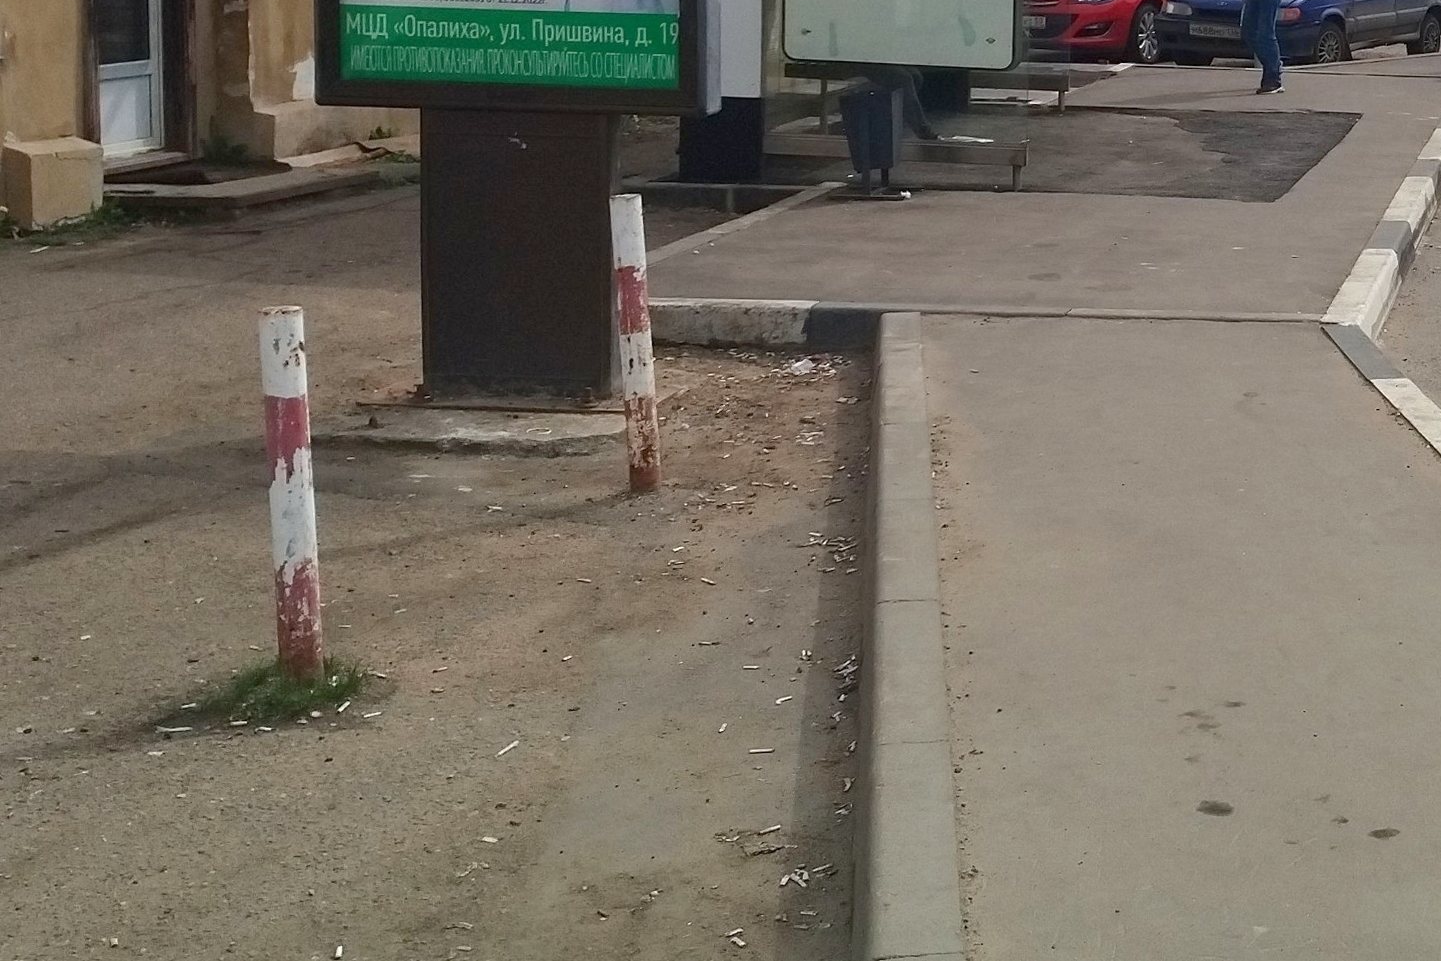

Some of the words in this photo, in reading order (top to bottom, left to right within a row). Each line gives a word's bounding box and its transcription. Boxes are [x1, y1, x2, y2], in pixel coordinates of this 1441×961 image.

[346, 13, 388, 39] МЦД
[394, 14, 494, 41] «Опалиха»,
[500, 23, 526, 45] ул.
[532, 18, 629, 46] Пришвина,
[635, 27, 652, 47] д.
[659, 22, 679, 44] 19
